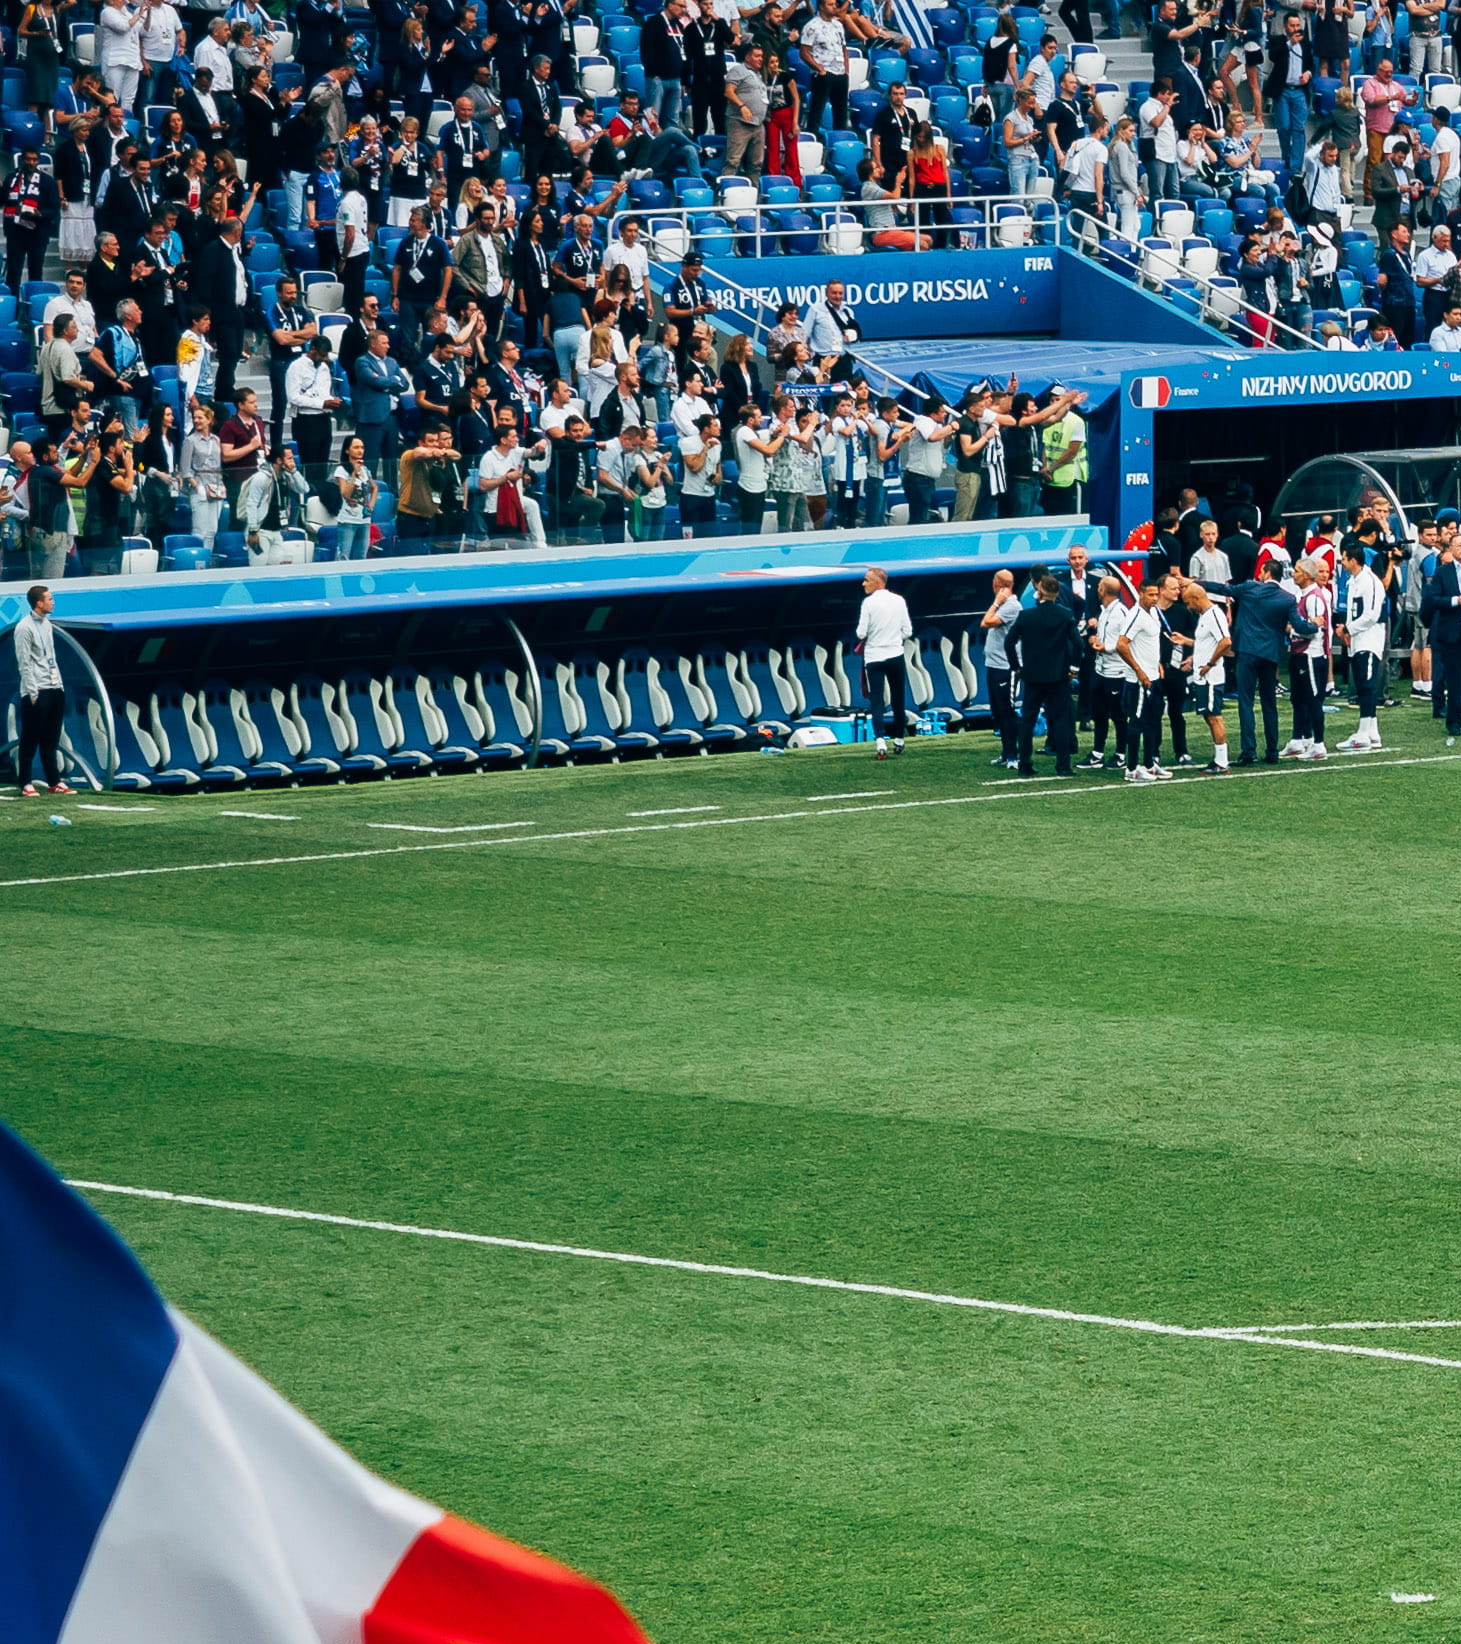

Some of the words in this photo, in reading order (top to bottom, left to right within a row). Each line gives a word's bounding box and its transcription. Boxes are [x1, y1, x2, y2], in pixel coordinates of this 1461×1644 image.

[1024, 257, 1053, 271] FIFA
[704, 287, 737, 311] 018
[740, 286, 784, 310] FIFA
[786, 283, 863, 307] WOD
[865, 281, 909, 305] CUP
[913, 278, 989, 303] RUSSIA
[1242, 372, 1309, 397] NIZHNY
[1312, 369, 1413, 394] NOVGOROD
[1174, 385, 1199, 397] France
[1126, 472, 1149, 486] FIFA
